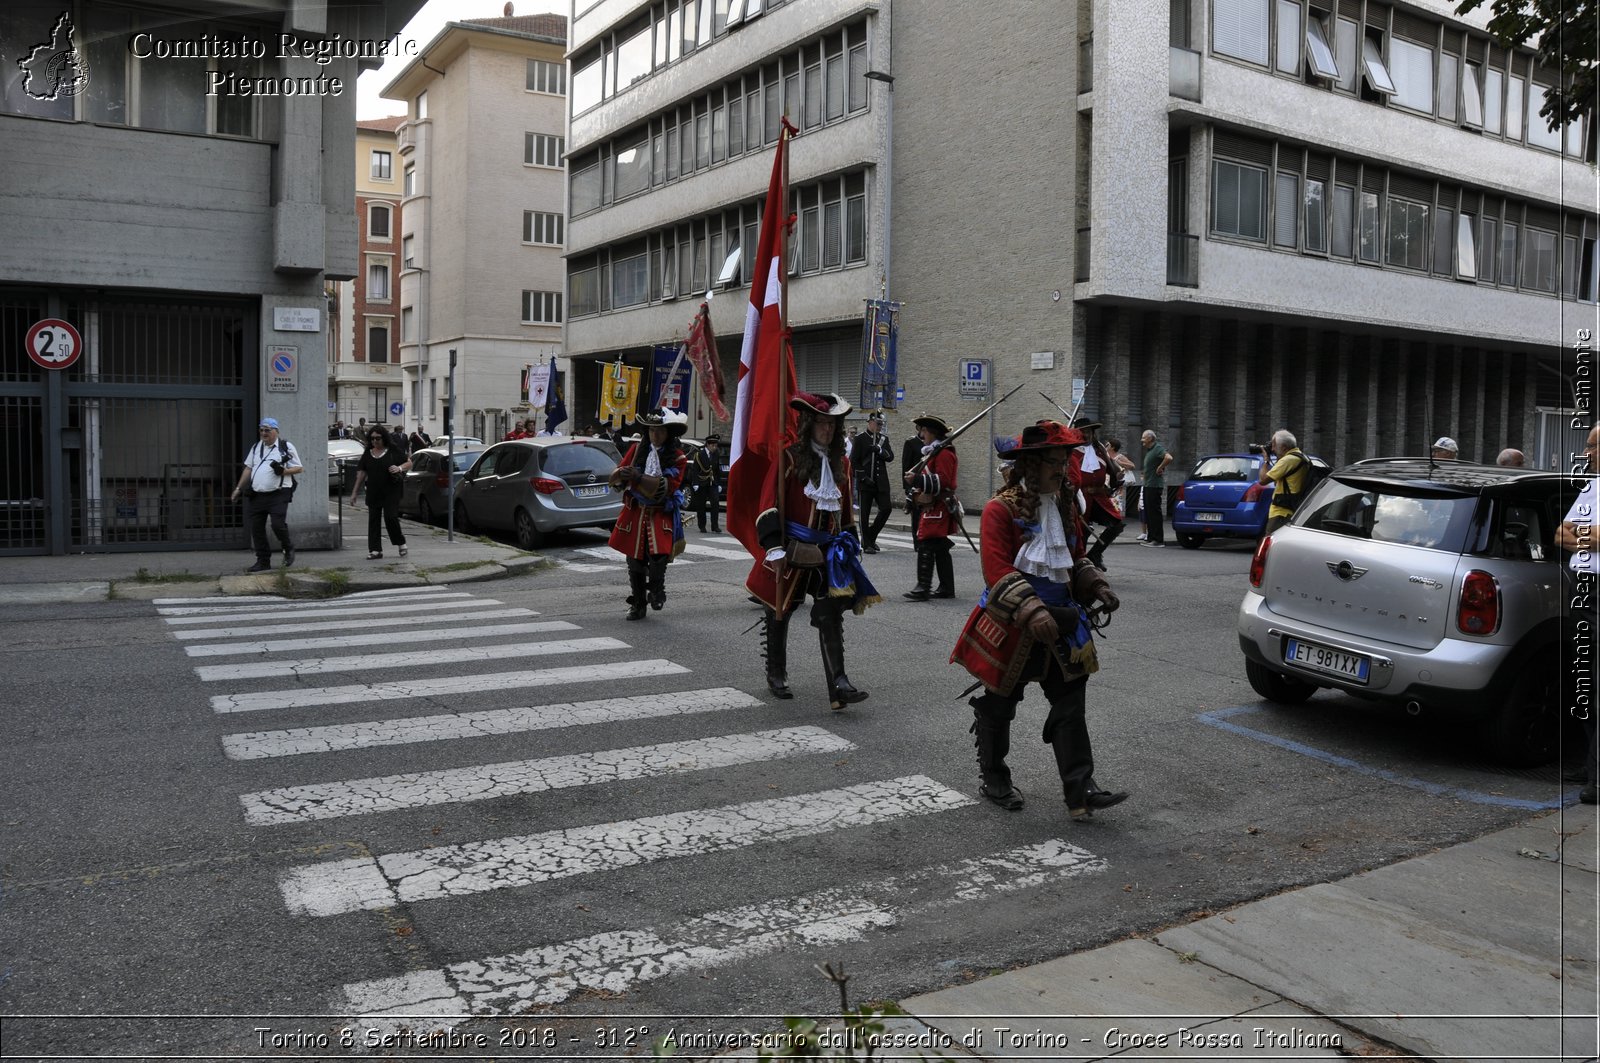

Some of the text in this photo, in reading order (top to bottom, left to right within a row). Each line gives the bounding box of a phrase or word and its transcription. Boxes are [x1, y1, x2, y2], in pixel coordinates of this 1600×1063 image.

[970, 365, 980, 378] P
[1276, 586, 1428, 624] COUNTRYMAN
[1295, 644, 1359, 675] ET 981XX
